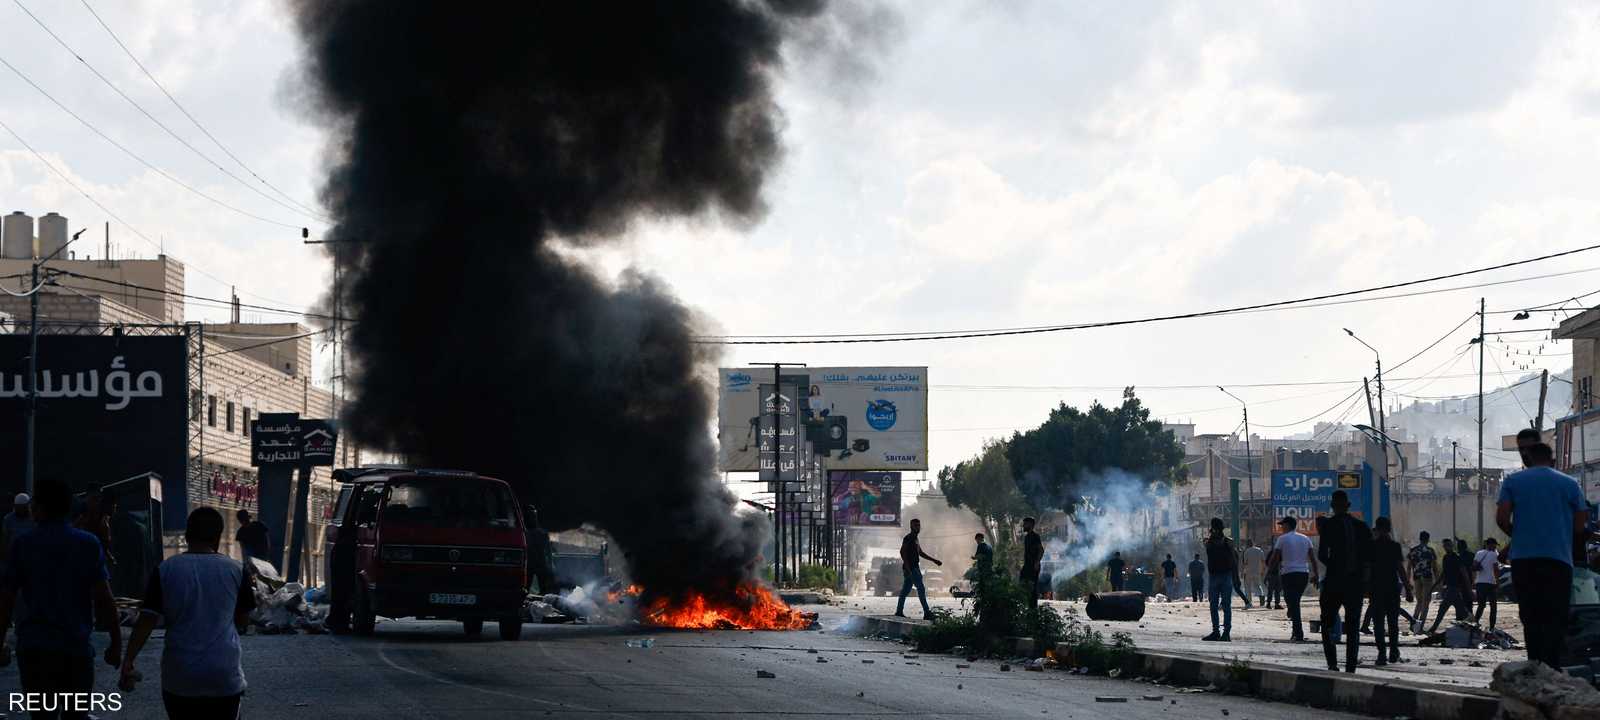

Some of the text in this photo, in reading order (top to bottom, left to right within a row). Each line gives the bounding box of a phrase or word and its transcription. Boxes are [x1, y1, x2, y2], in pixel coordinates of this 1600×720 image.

[256, 423, 301, 435] مؤسسة
[257, 450, 301, 463] التجارية
[1284, 474, 1333, 491] موارد
[1275, 507, 1313, 518] LIQUI
